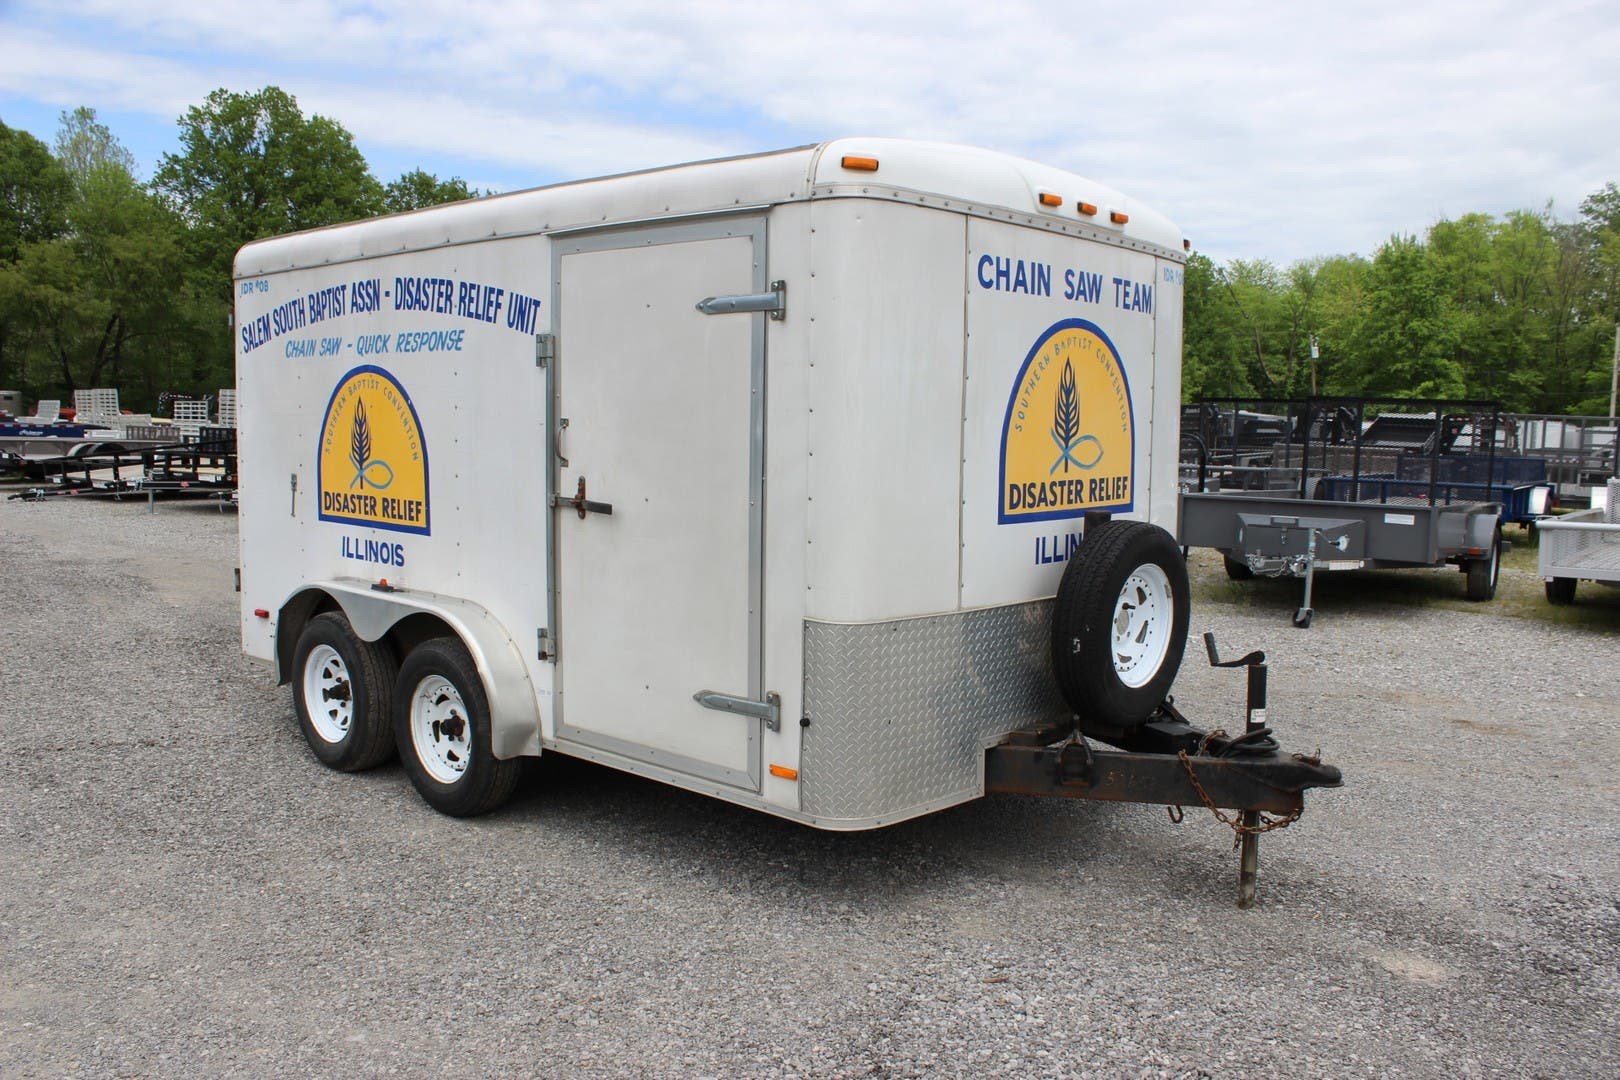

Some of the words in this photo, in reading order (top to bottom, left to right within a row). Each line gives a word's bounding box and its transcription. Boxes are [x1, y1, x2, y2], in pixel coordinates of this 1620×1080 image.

[240, 282, 254, 295] IDR
[977, 254, 1051, 297] CHAIN
[1064, 269, 1103, 304] SAW
[1112, 277, 1152, 314] TEAM
[241, 319, 272, 354] SALEM
[274, 297, 306, 336] SOUTH
[308, 284, 347, 325] BAPTIST
[350, 278, 381, 314] ASSN
[394, 277, 454, 315] DISASTER
[457, 281, 504, 325] RELIEF
[507, 292, 541, 336] UNIT
[285, 336, 316, 358] CHAIN
[319, 336, 342, 356] SAW
[356, 334, 389, 355] QUICK
[395, 329, 465, 353] RESPONSE
[348, 378, 380, 393] BAPTIST
[1014, 355, 1050, 433] SOUTHERN
[1053, 336, 1093, 356] BAPTIST
[1095, 348, 1128, 433] CONVENTION
[323, 491, 378, 516] DISASTER
[382, 497, 423, 522] RELIEF
[1008, 479, 1084, 510] DISASTER
[1088, 476, 1129, 503] RELIEF
[341, 535, 405, 567] ILLINOIS
[1035, 532, 1083, 565] ILLIN
